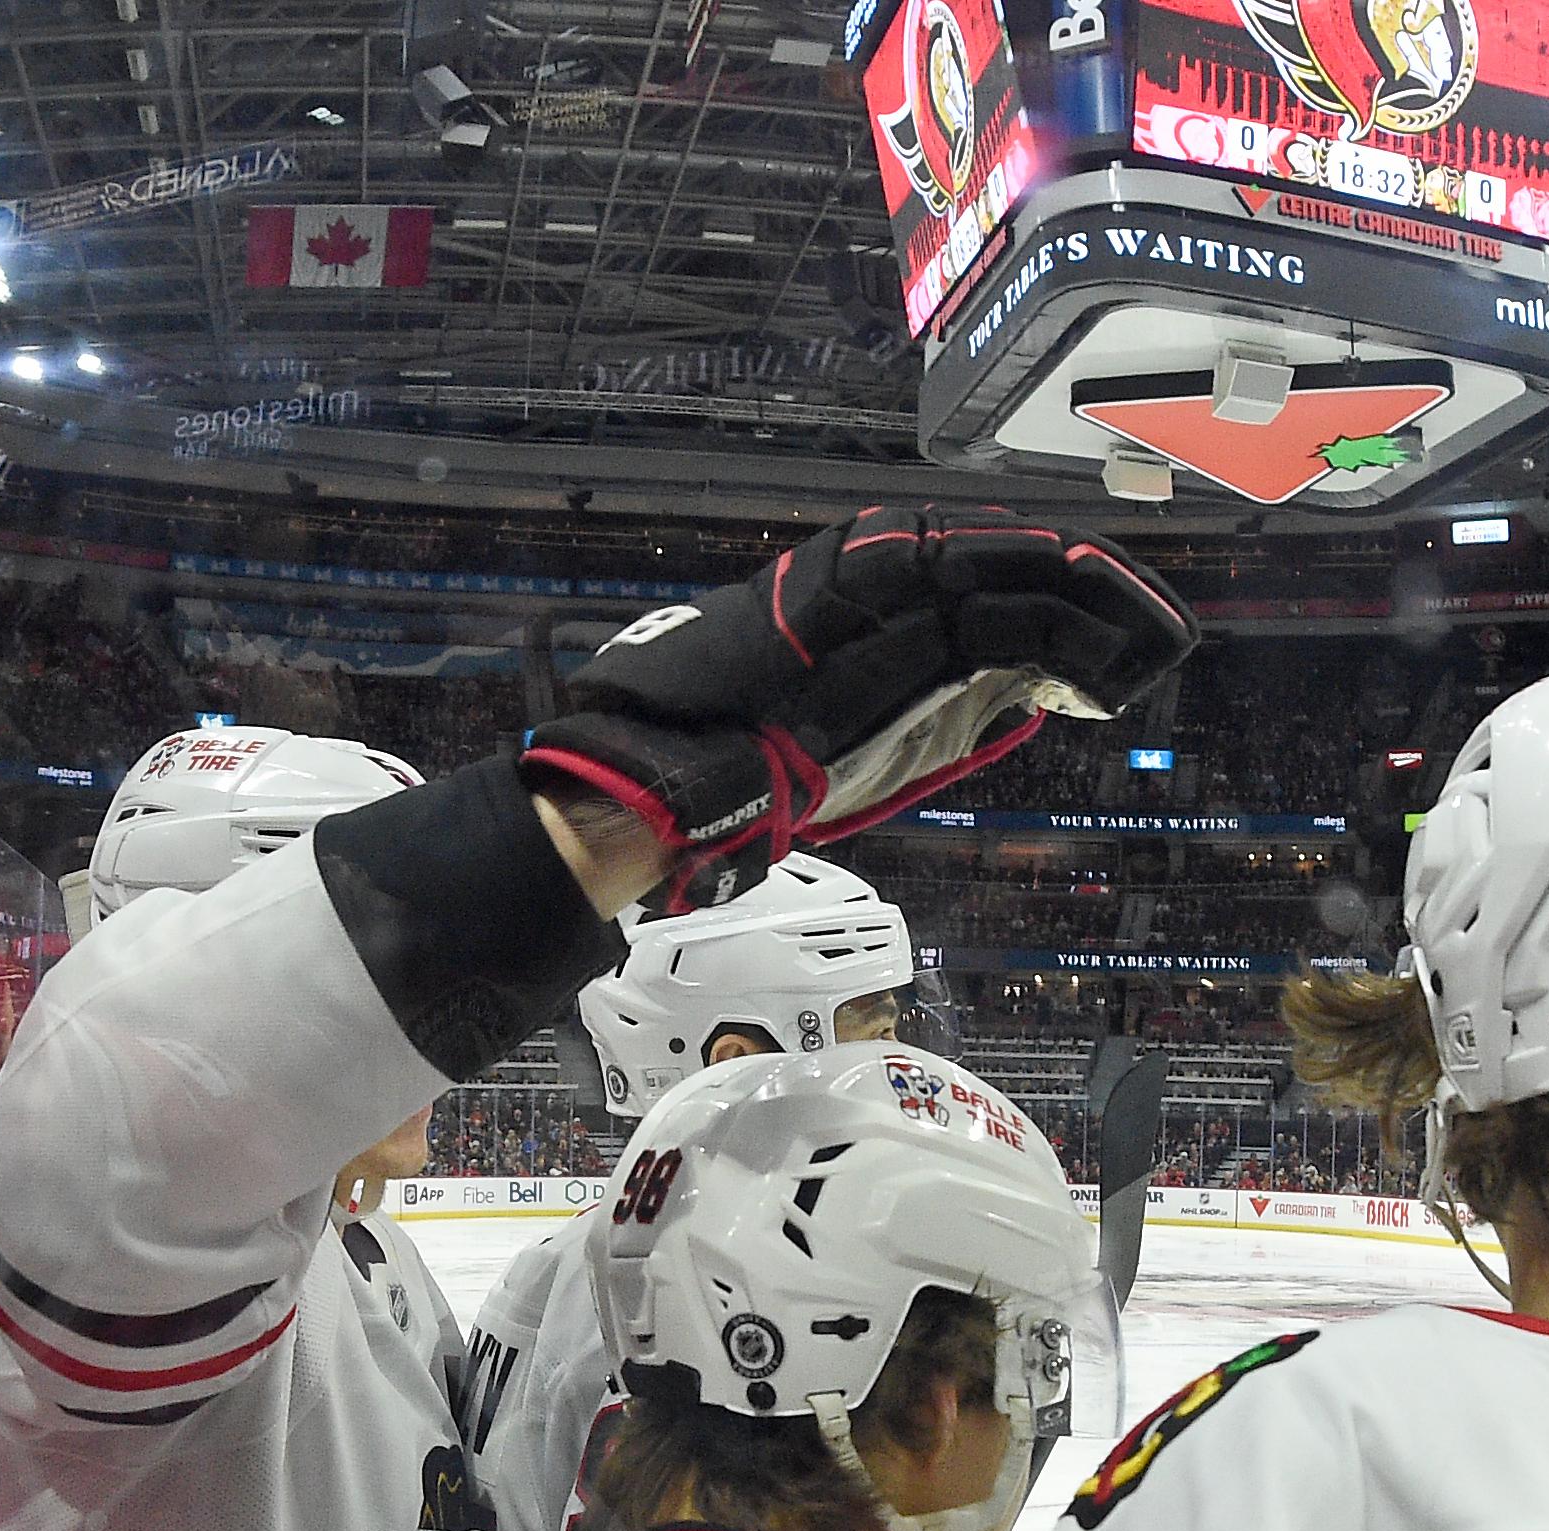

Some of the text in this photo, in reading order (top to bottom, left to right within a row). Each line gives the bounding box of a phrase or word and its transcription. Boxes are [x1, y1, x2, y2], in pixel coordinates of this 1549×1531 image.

[1240, 127, 1253, 150] 0
[1338, 160, 1406, 197] 18:32
[1480, 182, 1492, 204] 0
[969, 300, 1002, 358] YOUR
[1003, 232, 1089, 309] TABLE'S
[1105, 228, 1305, 285] WAITING
[37, 765, 93, 781] milestones
[186, 755, 244, 771] TIRE
[919, 808, 976, 822] milestones
[1050, 814, 1240, 831] YOUR TABLE'S WAITING
[1057, 953, 1251, 971] YOUR TABLE'S WAITING
[950, 1081, 1027, 1134] BELLE
[463, 1186, 496, 1204] Fibe
[508, 1181, 543, 1203] Bell
[612, 1148, 683, 1226] 98
[1274, 1203, 1337, 1218] CANADIAN TIRE
[1352, 1200, 1410, 1228] The BRICK
